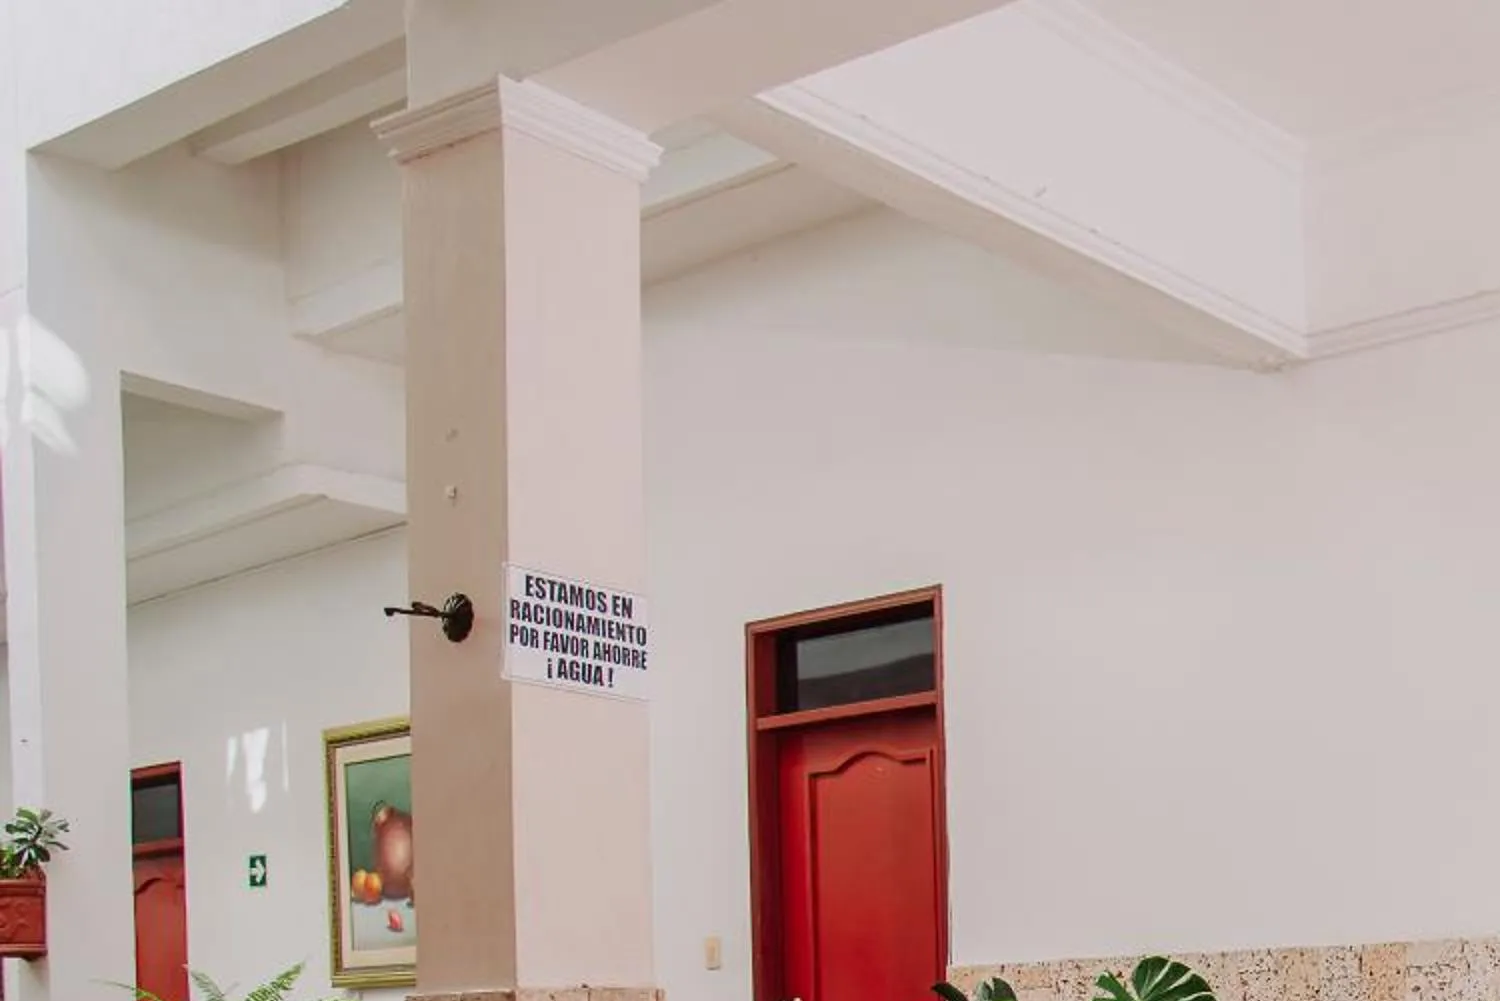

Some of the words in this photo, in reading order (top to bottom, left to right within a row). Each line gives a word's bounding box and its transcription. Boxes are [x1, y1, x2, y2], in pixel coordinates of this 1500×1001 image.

[525, 574, 607, 613] ESTAMOS
[611, 594, 633, 619] EN
[509, 598, 647, 647] RACIONAMIENTO
[509, 623, 539, 649] POR
[543, 631, 589, 659] FAVOR
[593, 641, 648, 670] AHORRE
